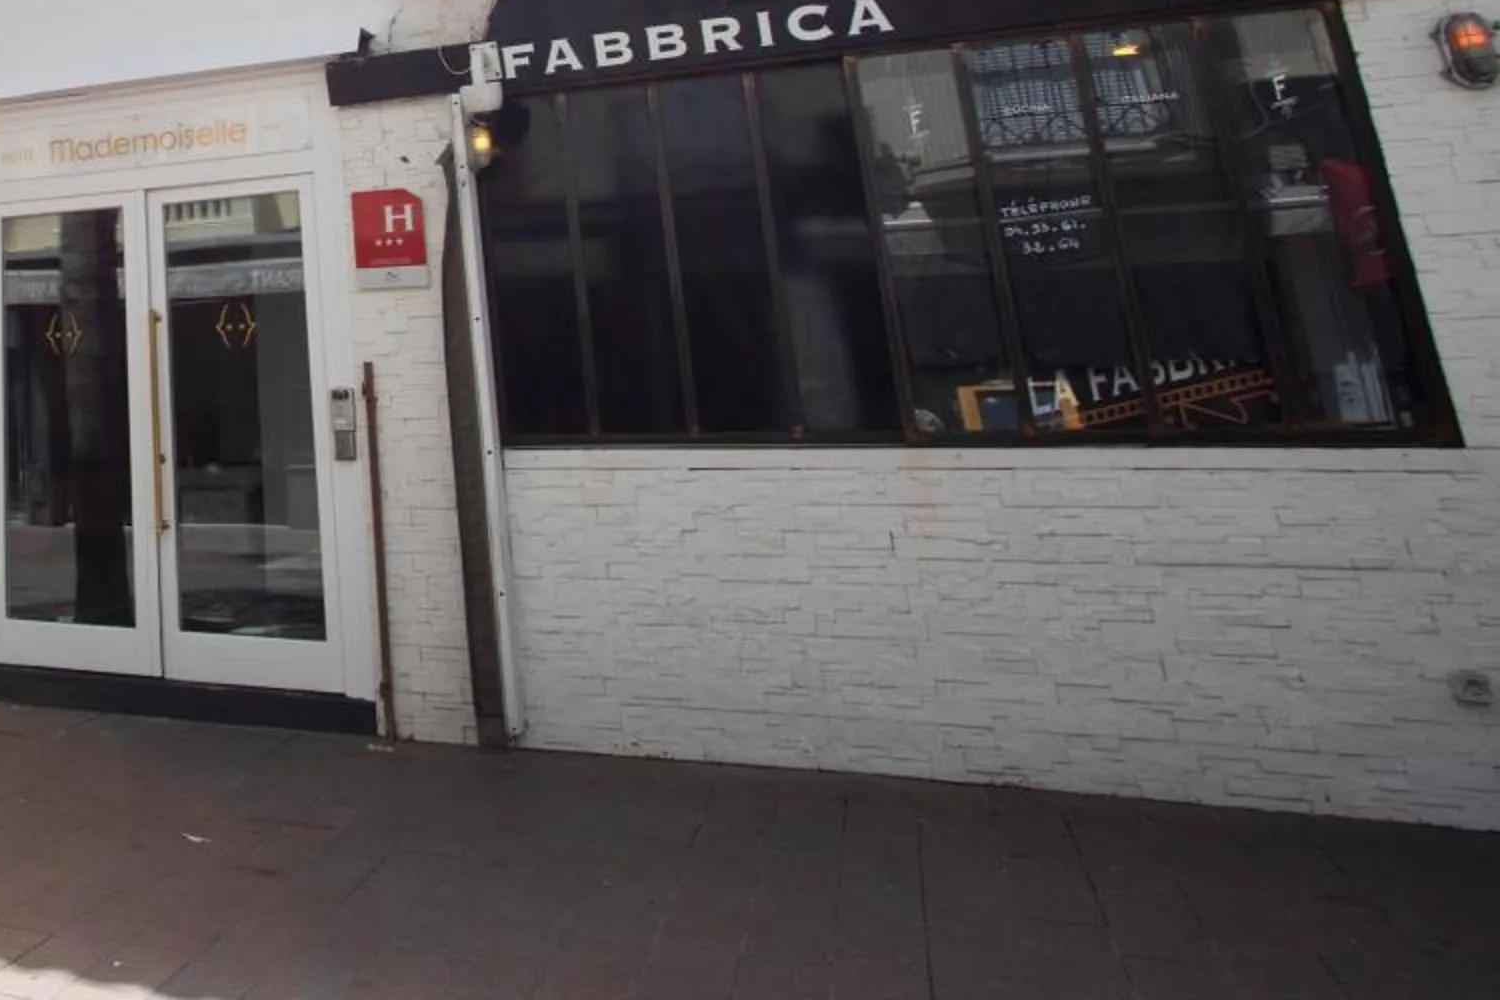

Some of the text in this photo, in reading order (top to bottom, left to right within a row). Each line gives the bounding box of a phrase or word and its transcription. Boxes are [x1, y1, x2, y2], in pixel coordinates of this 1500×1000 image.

[48, 118, 247, 164] Mademoiselle
[384, 203, 414, 233] H
[1027, 370, 1079, 415] LA
